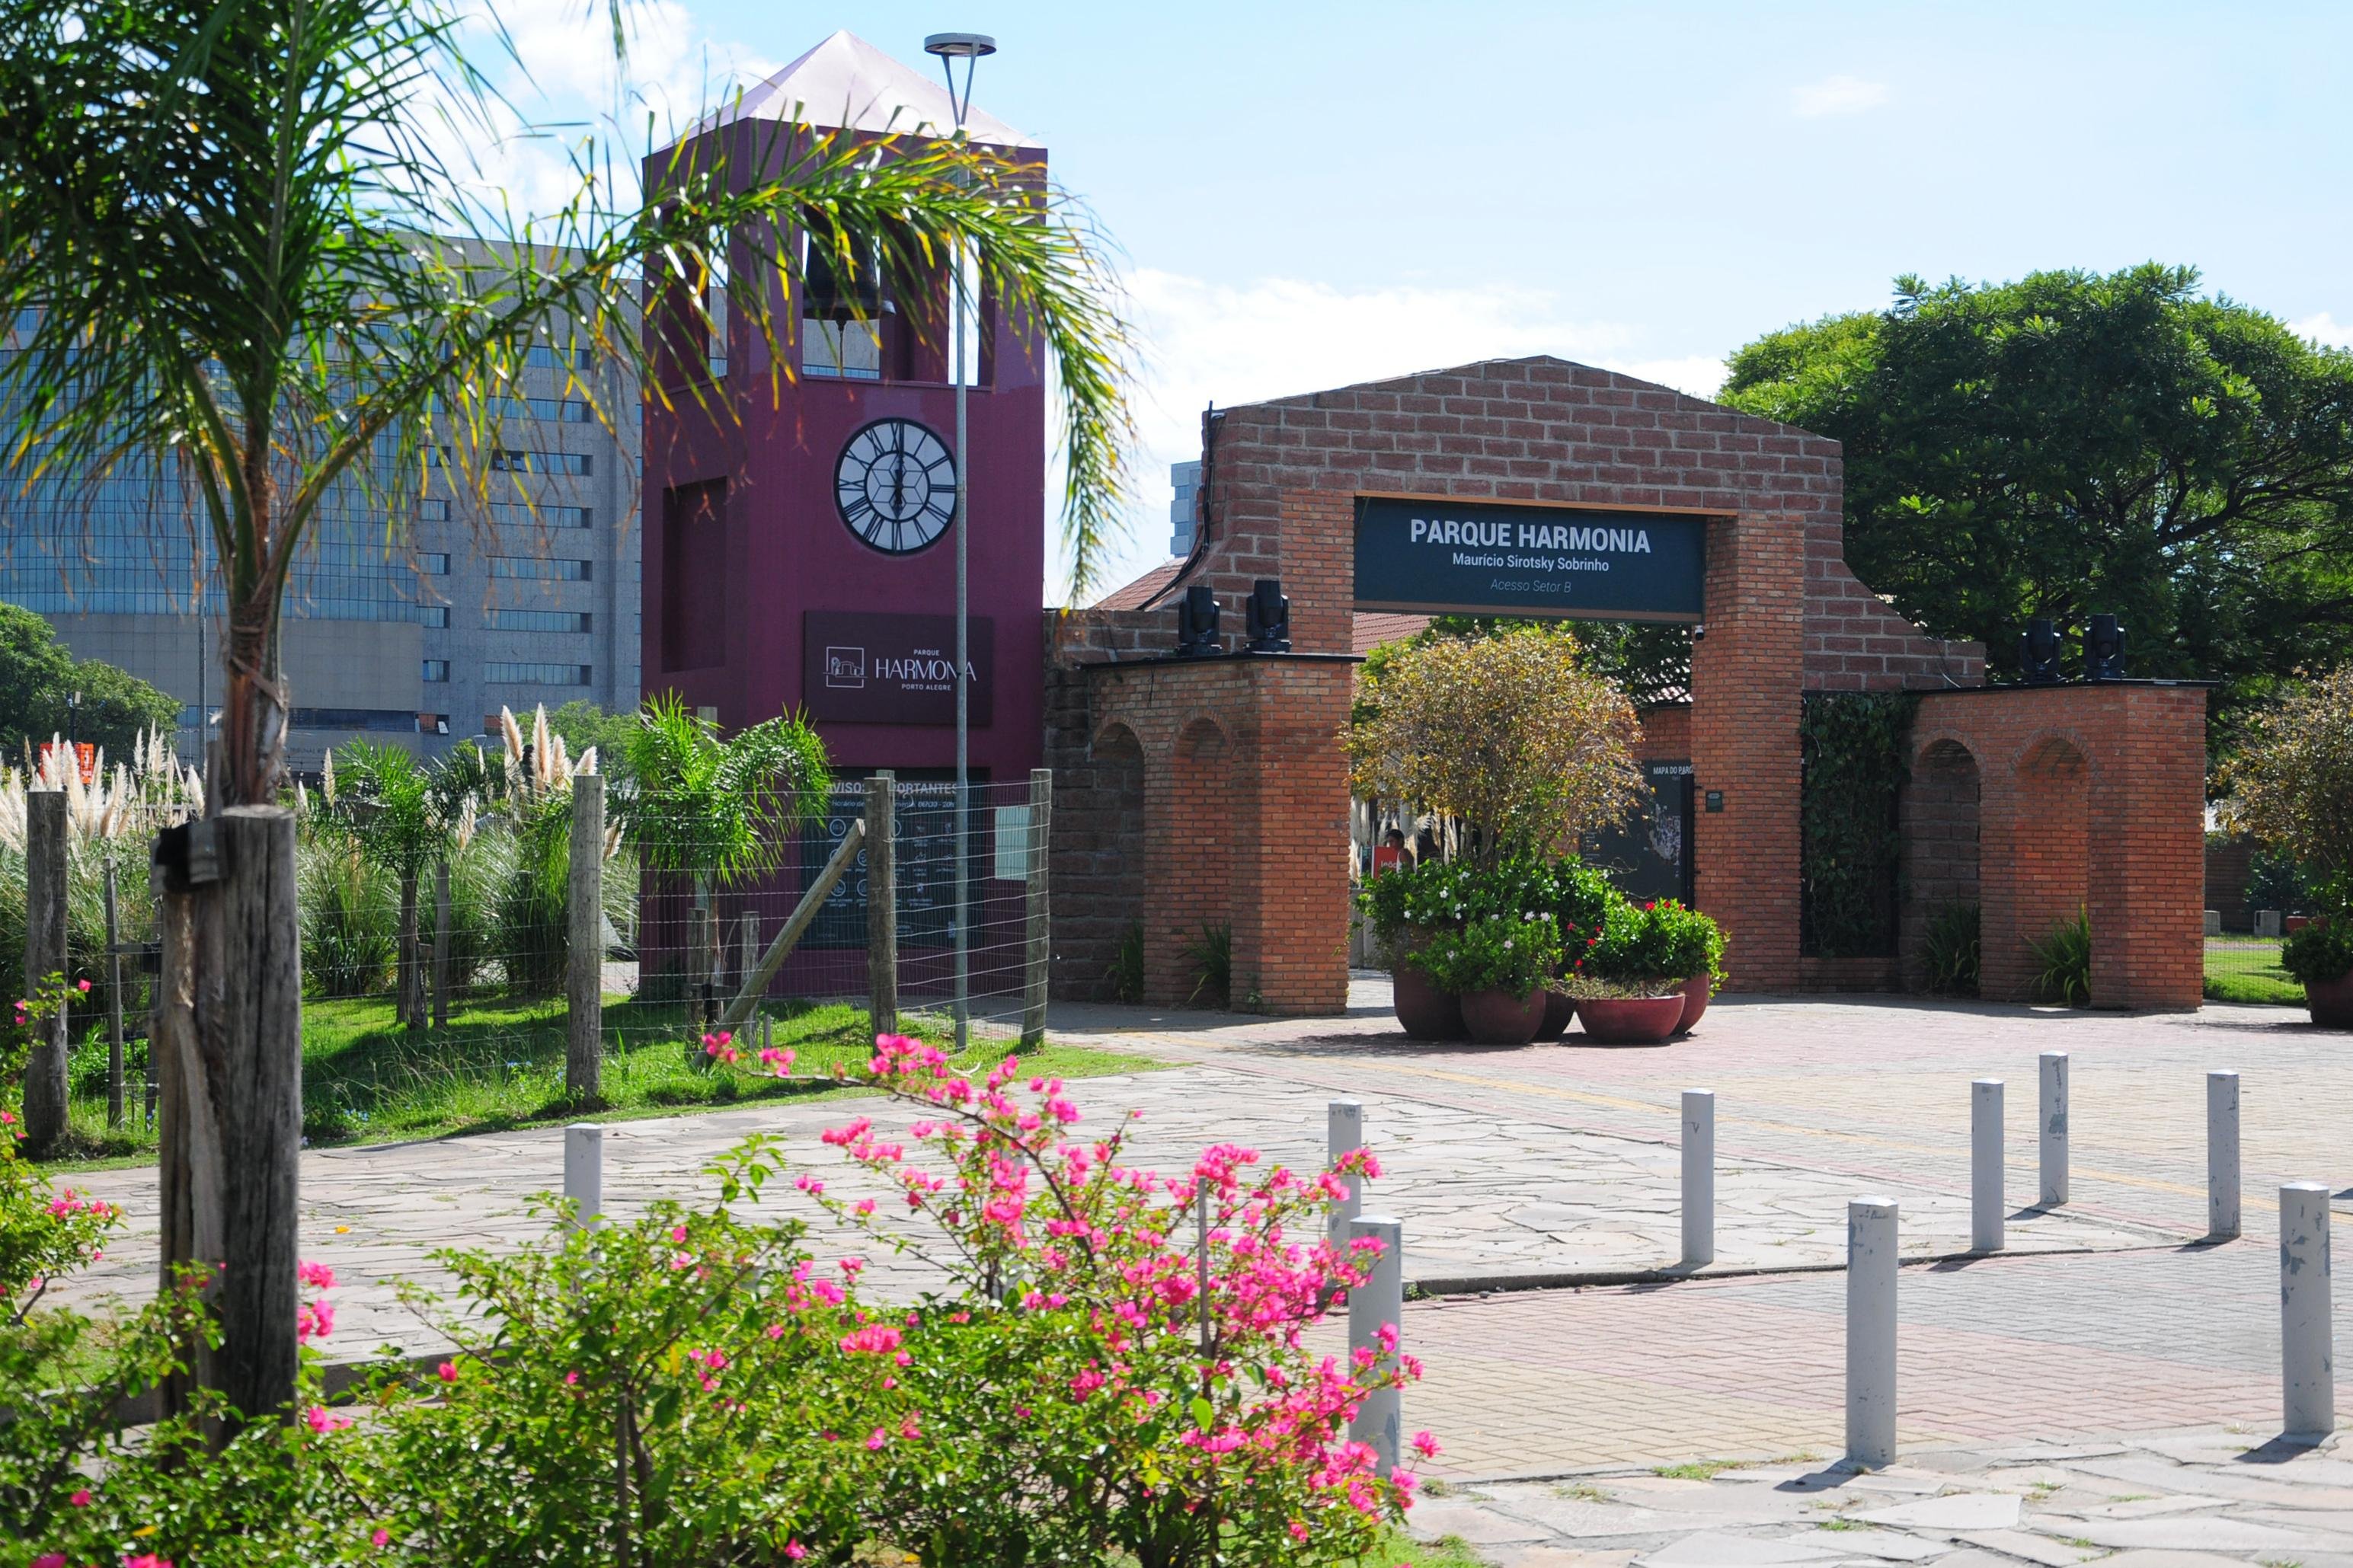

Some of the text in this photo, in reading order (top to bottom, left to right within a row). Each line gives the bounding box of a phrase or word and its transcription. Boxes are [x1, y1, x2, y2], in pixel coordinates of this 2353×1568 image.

[1410, 519, 1651, 554] PARQUE HARMONIA
[1452, 551, 1610, 573] Maurício Sirotsky Sobrinho
[1490, 578, 1572, 594] Acesso Setor B
[875, 658, 977, 682] HARMONA
[1653, 766, 1669, 774] MAPA
[1670, 766, 1677, 774] DO
